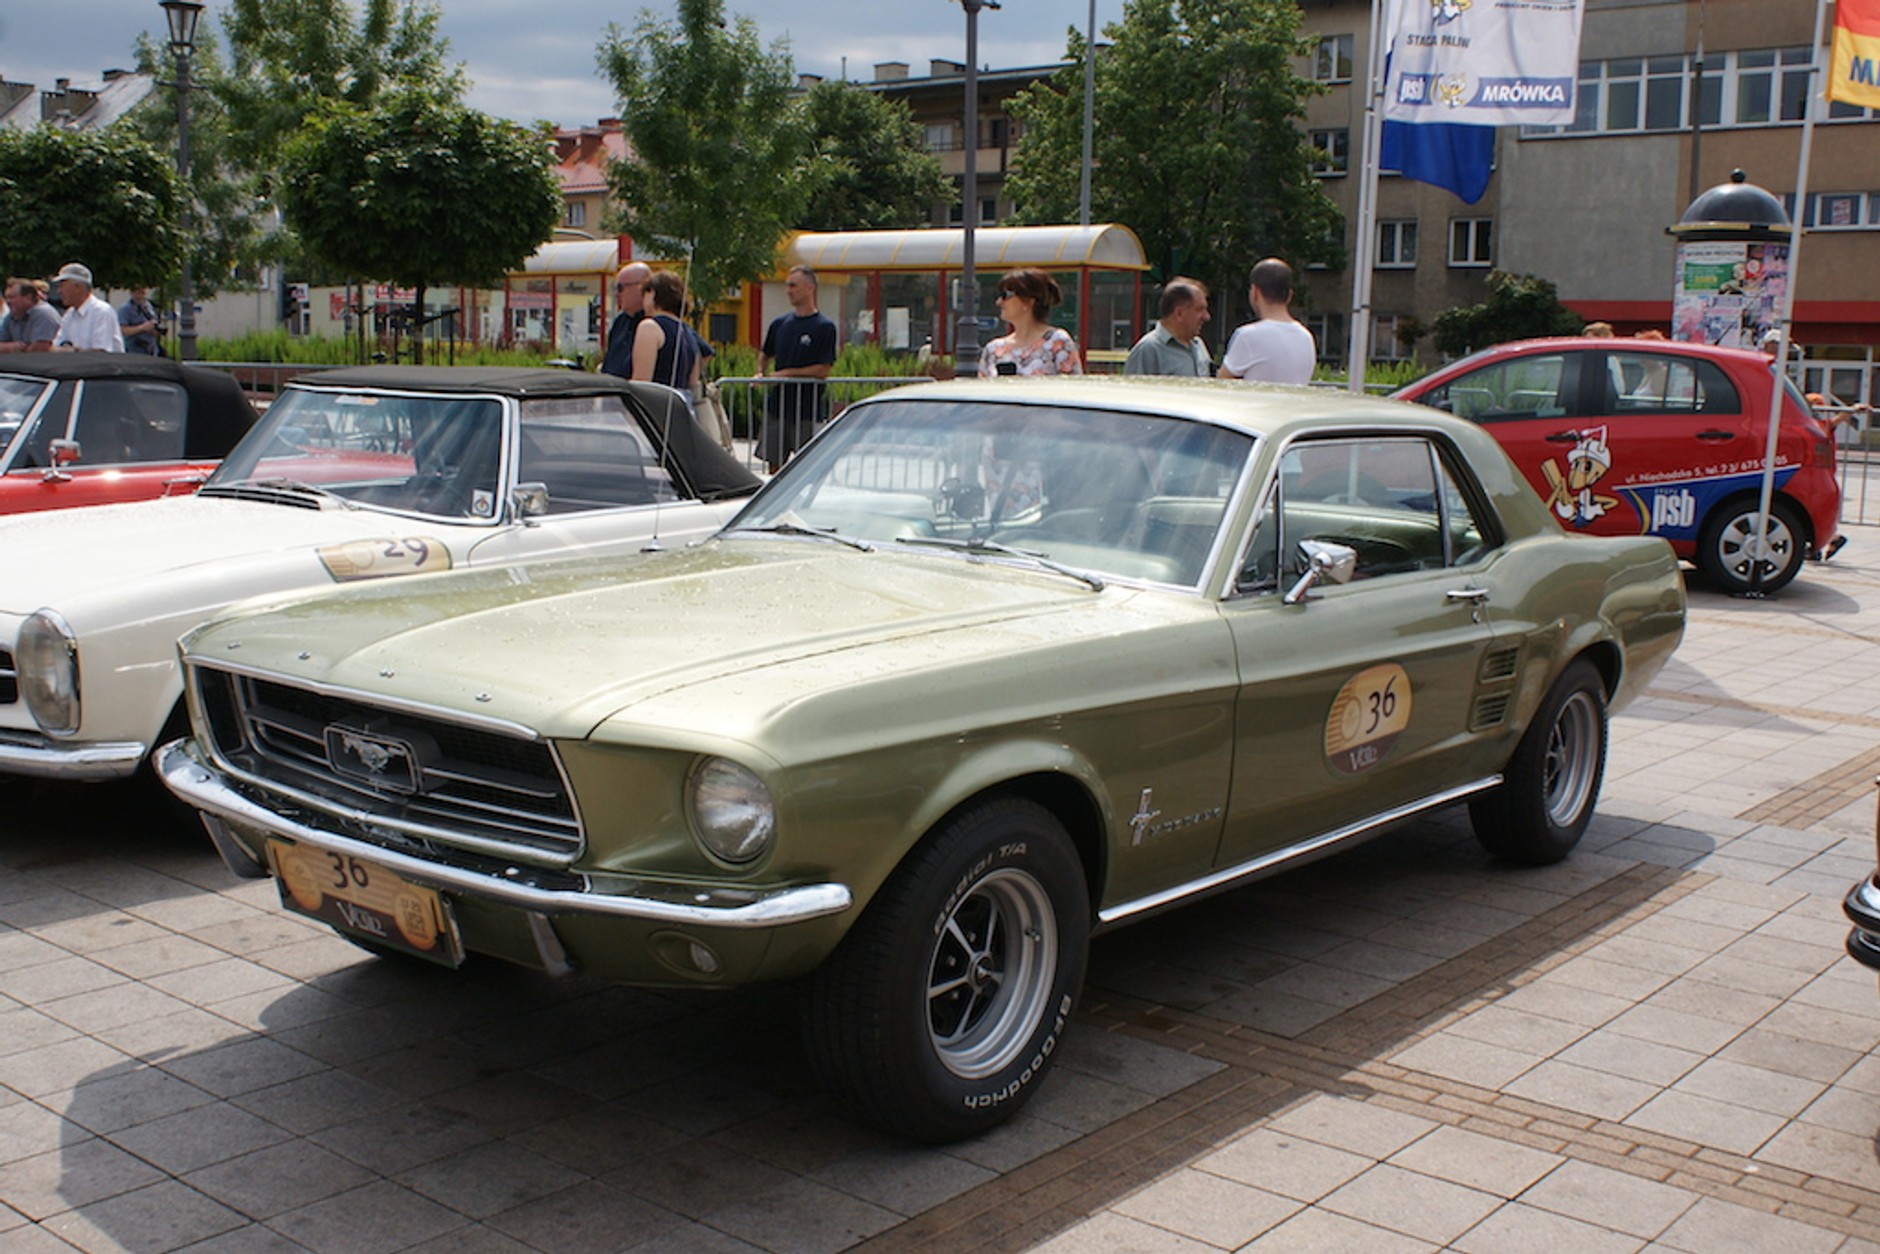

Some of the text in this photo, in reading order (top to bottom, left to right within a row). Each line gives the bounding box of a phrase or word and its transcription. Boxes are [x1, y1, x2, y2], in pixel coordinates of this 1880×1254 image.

[1849, 56, 1880, 87] M
[1482, 80, 1565, 102] MRÓWKA
[1651, 488, 1696, 532] psb
[375, 537, 429, 567] 29
[1366, 675, 1397, 734] 36
[999, 842, 1027, 857] T/A
[326, 851, 369, 889] 36
